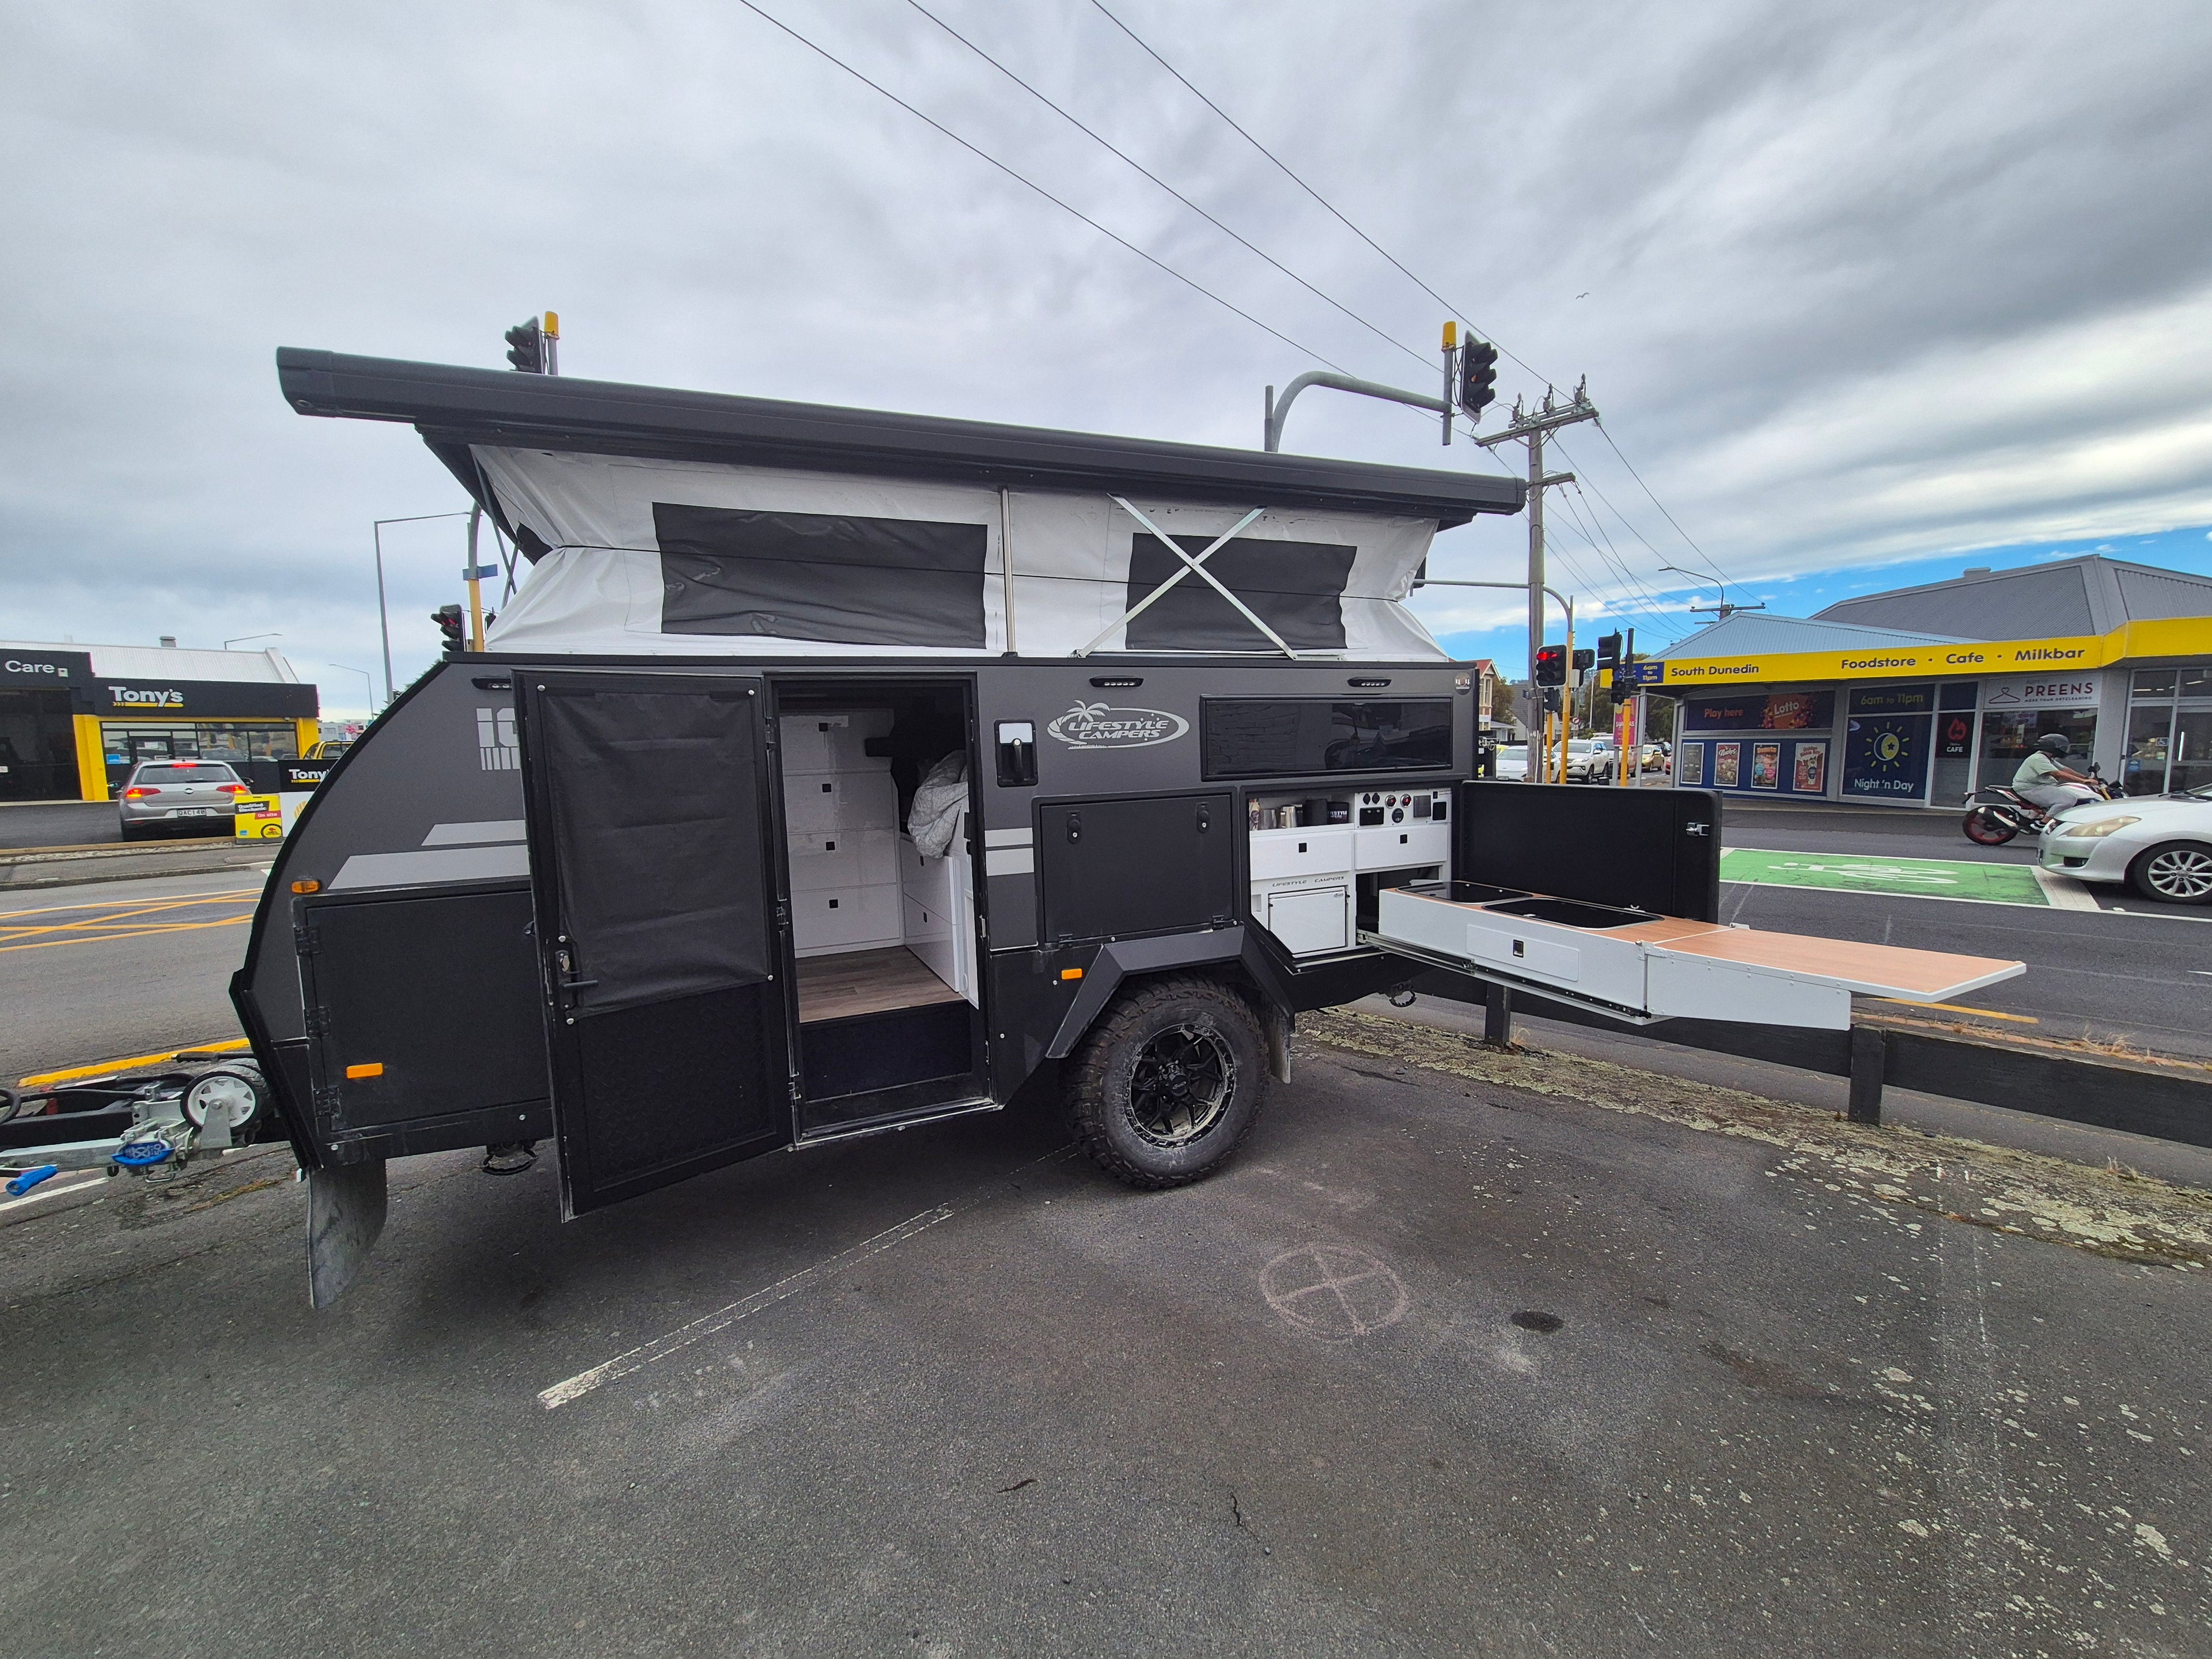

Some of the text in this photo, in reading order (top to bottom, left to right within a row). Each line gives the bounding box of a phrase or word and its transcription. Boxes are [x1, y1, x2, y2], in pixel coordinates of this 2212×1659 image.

[1841, 647, 2085, 669] Foodstore Cafe Milkbar
[5, 660, 55, 673] Care
[1671, 664, 1759, 677] South Dunedin
[108, 685, 184, 707] Tony's
[2024, 682, 2093, 697] PREENS
[1861, 695, 1884, 705] 6am
[1897, 693, 1924, 706] 11pm
[1704, 707, 1744, 719] Play here
[1774, 700, 1800, 715] Lotto
[1068, 720, 1170, 731] LIFESTYLE
[1078, 729, 1161, 739] CAMPERS
[1854, 778, 1880, 791] Night
[1893, 780, 1914, 793] Day
